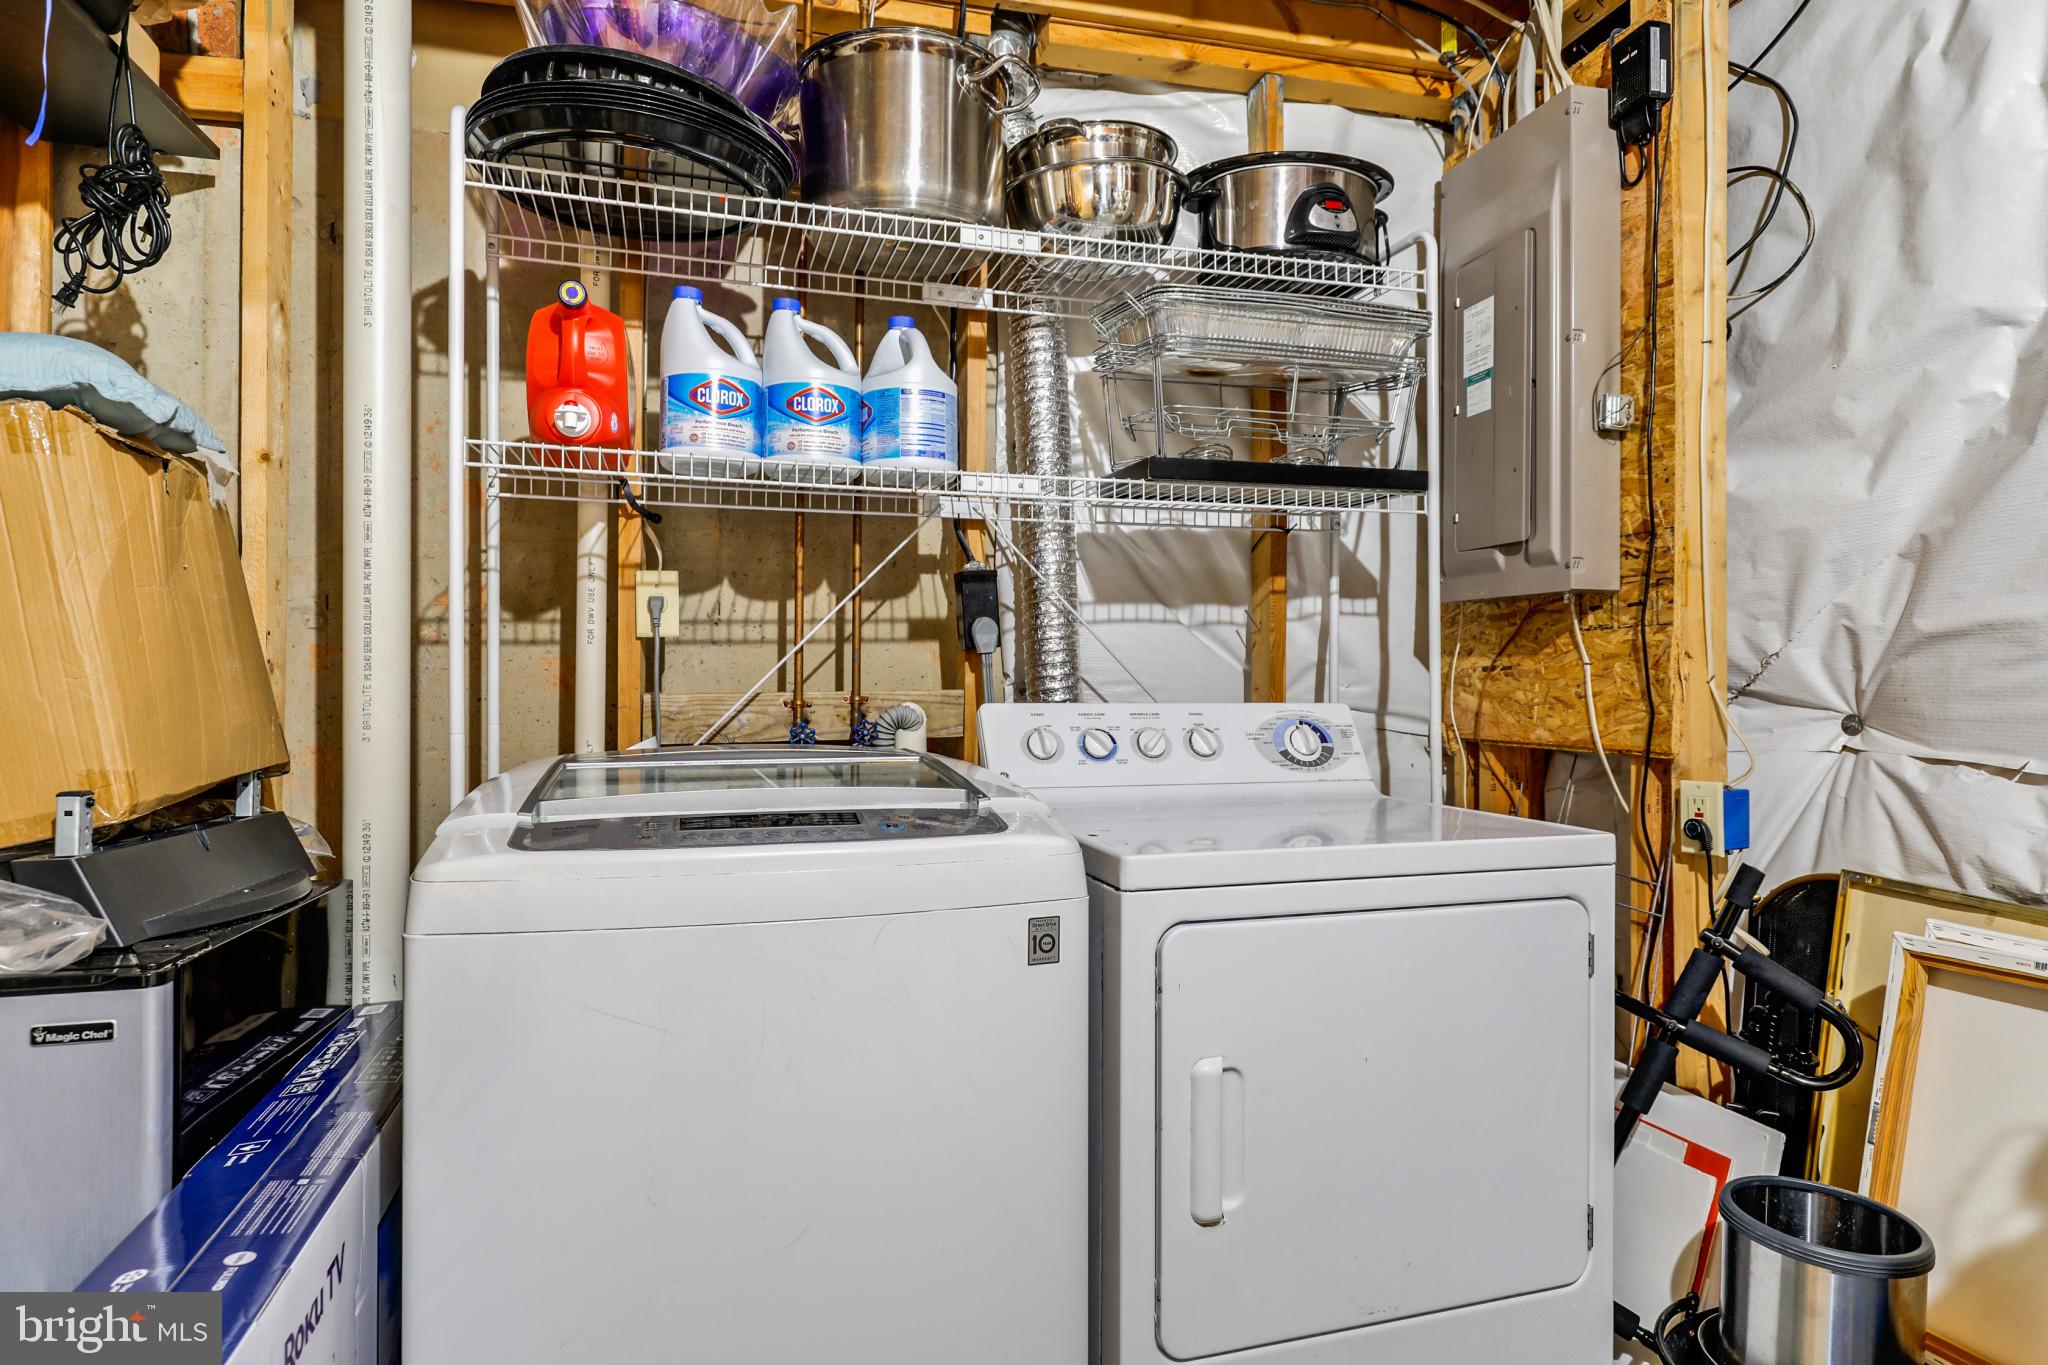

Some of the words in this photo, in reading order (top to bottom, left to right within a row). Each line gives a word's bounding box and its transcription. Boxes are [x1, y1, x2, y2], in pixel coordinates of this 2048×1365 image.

[363, 269, 373, 316] BRISTOLITE
[697, 387, 744, 407] CLOROX
[793, 396, 839, 414] CLOROX
[587, 608, 595, 625] DWV
[587, 628, 595, 645] FOR
[362, 684, 372, 730] BRISTOLITE
[1032, 934, 1056, 954] 10
[45, 1031, 80, 1043] Magic
[326, 1241, 346, 1300] TV
